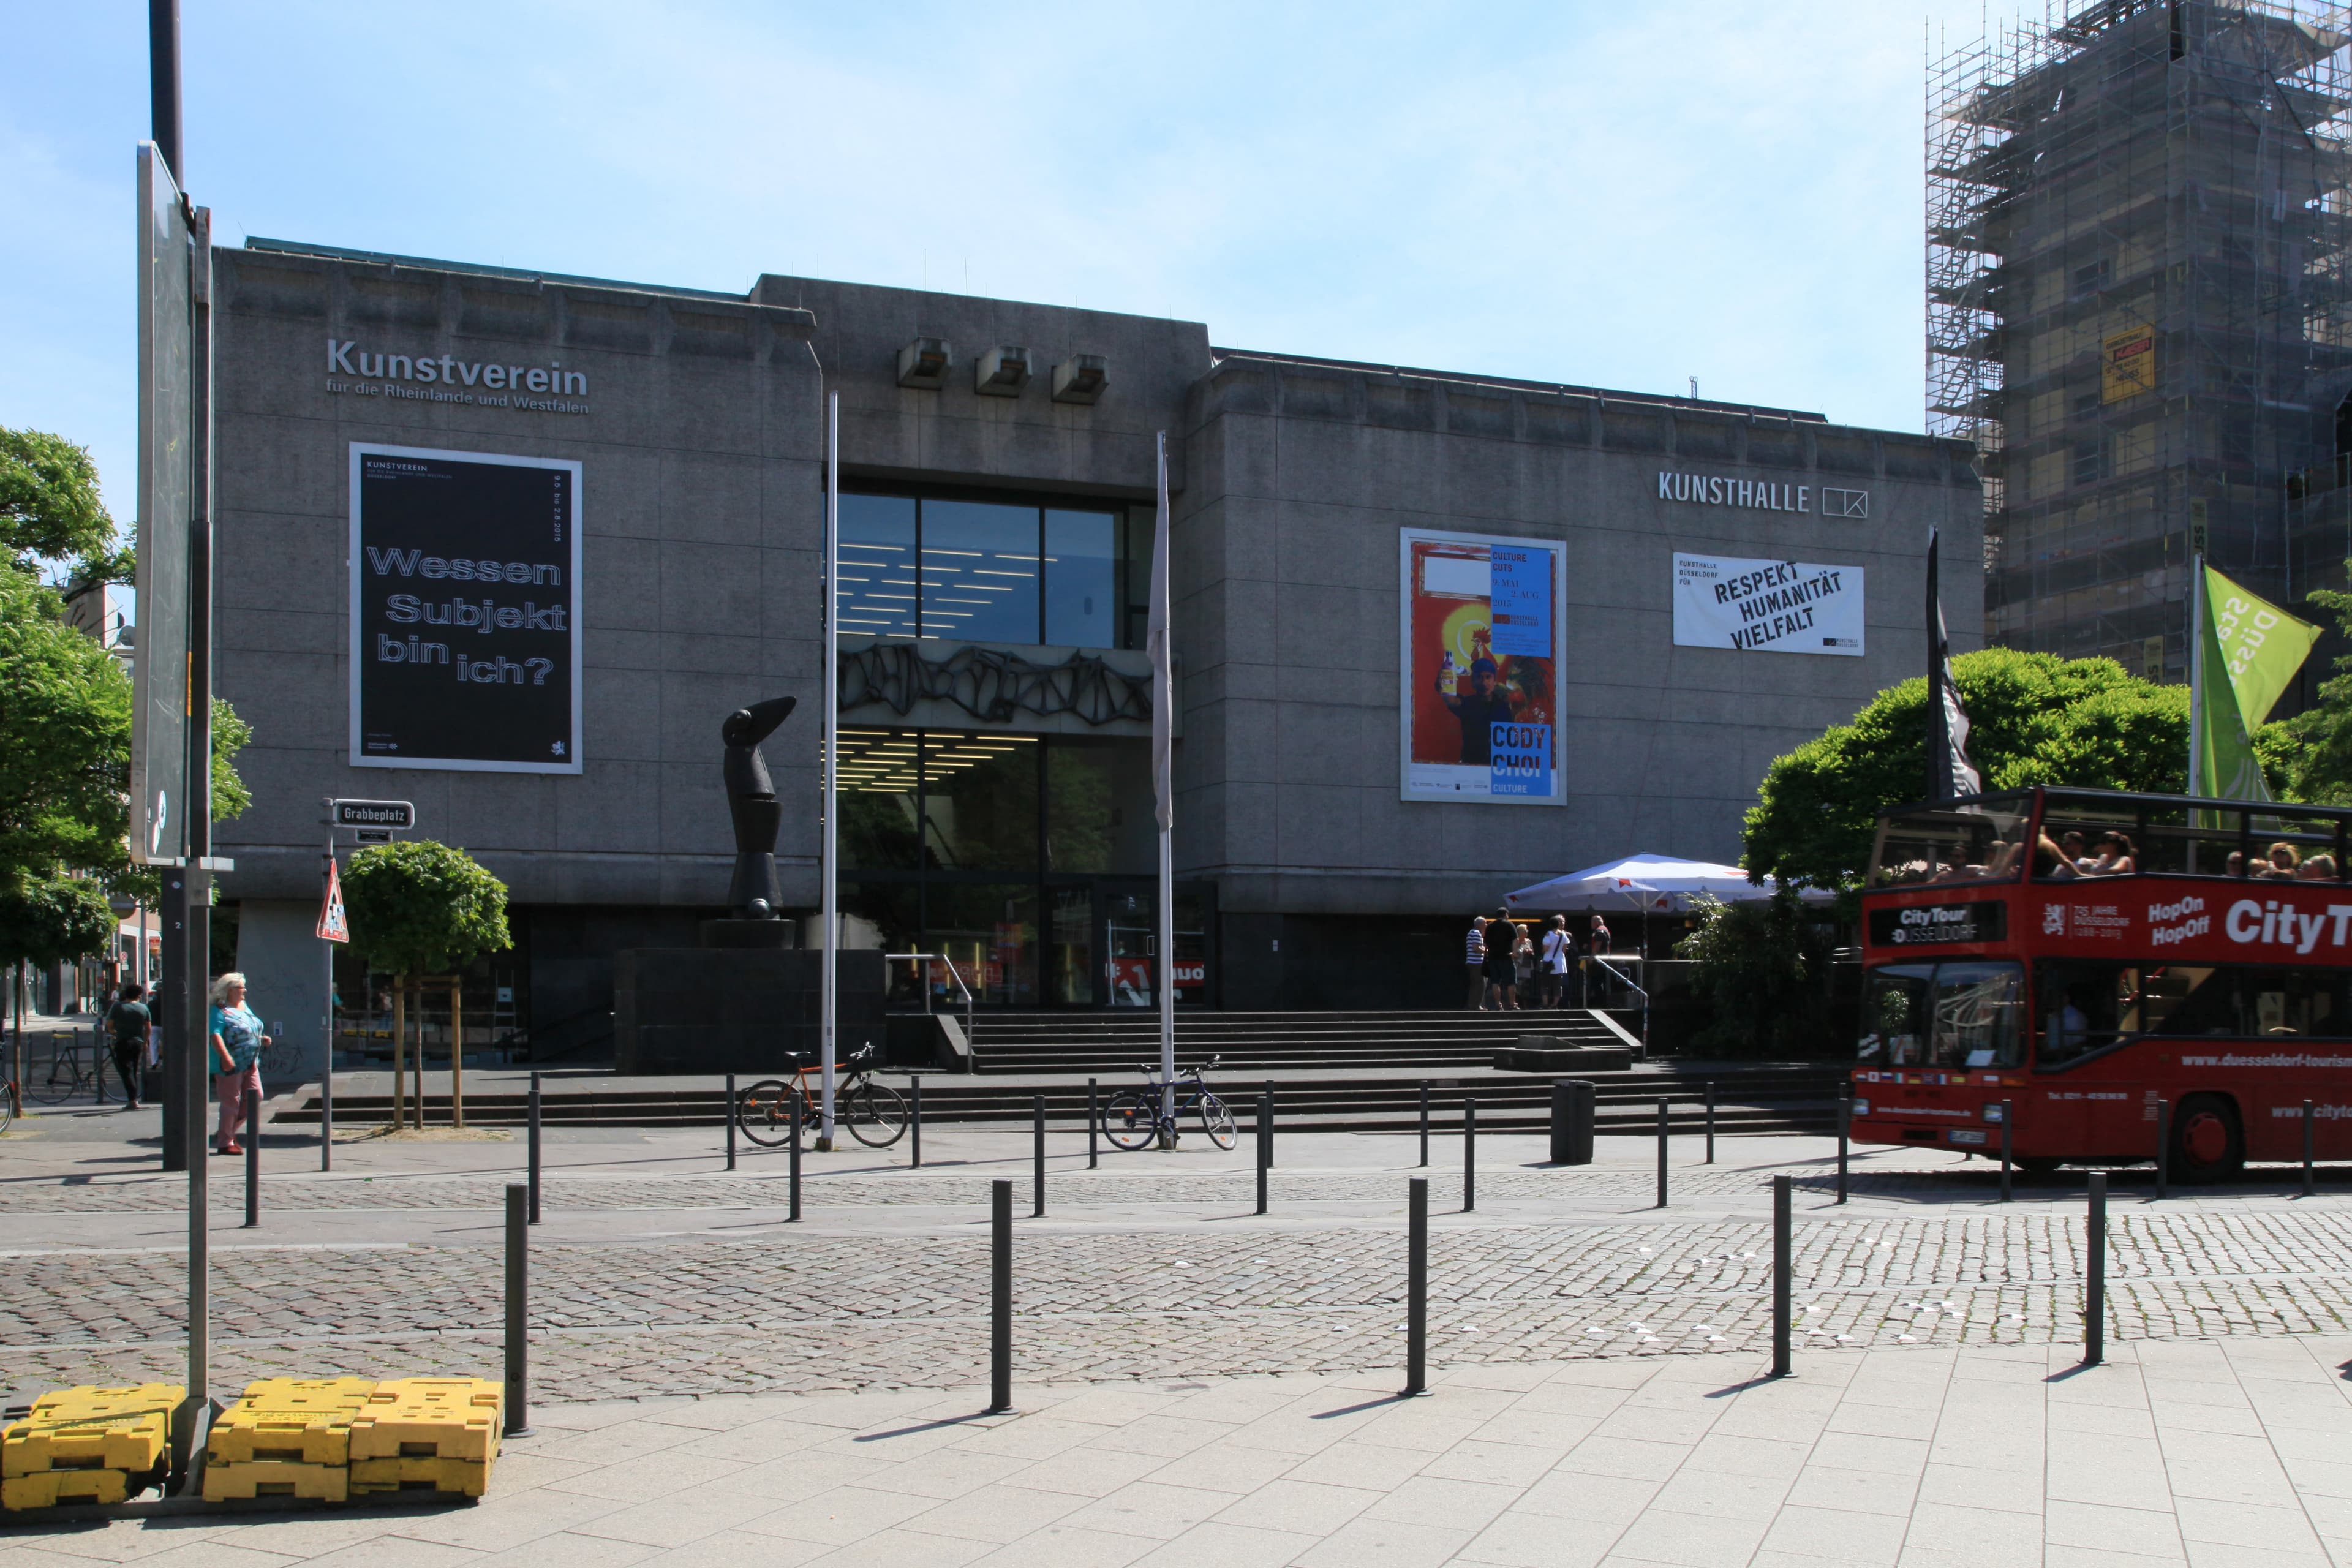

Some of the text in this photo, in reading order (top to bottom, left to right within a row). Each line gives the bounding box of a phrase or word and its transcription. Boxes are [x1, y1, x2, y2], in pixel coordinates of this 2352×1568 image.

[328, 339, 587, 395] Kunstverein
[326, 379, 589, 415] für die Rheinlande und Westfalen
[368, 461, 428, 471] KUNSTVEREIN
[1658, 472, 1809, 513] KUNSTHALLE
[367, 546, 561, 586] Wessen
[1493, 551, 1527, 562] CULTURE
[1493, 563, 1513, 573] CUTS
[1679, 560, 1717, 569] KUNSTHALLE
[1502, 579, 1519, 588] MAI
[1679, 569, 1719, 578] DÜSSELDORF
[1679, 578, 1692, 586] FÜR
[1714, 560, 1797, 605] RESPEKT
[1739, 570, 1842, 622] HUMANITÄT
[386, 594, 567, 633] Subjekt
[1730, 606, 1814, 650] VIELFALT
[377, 633, 449, 665] bin
[457, 654, 554, 685] ich?
[1493, 725, 1545, 749] CODY
[1493, 754, 1540, 778] CHOI
[1493, 783, 1528, 794] CULTURE
[345, 807, 405, 823] Grabbeplatz
[2073, 916, 2131, 926] DÜSSELDORF
[2092, 906, 2118, 916] JAHRE
[2148, 896, 2204, 922] HopOn
[2152, 916, 2211, 946] HopOff
